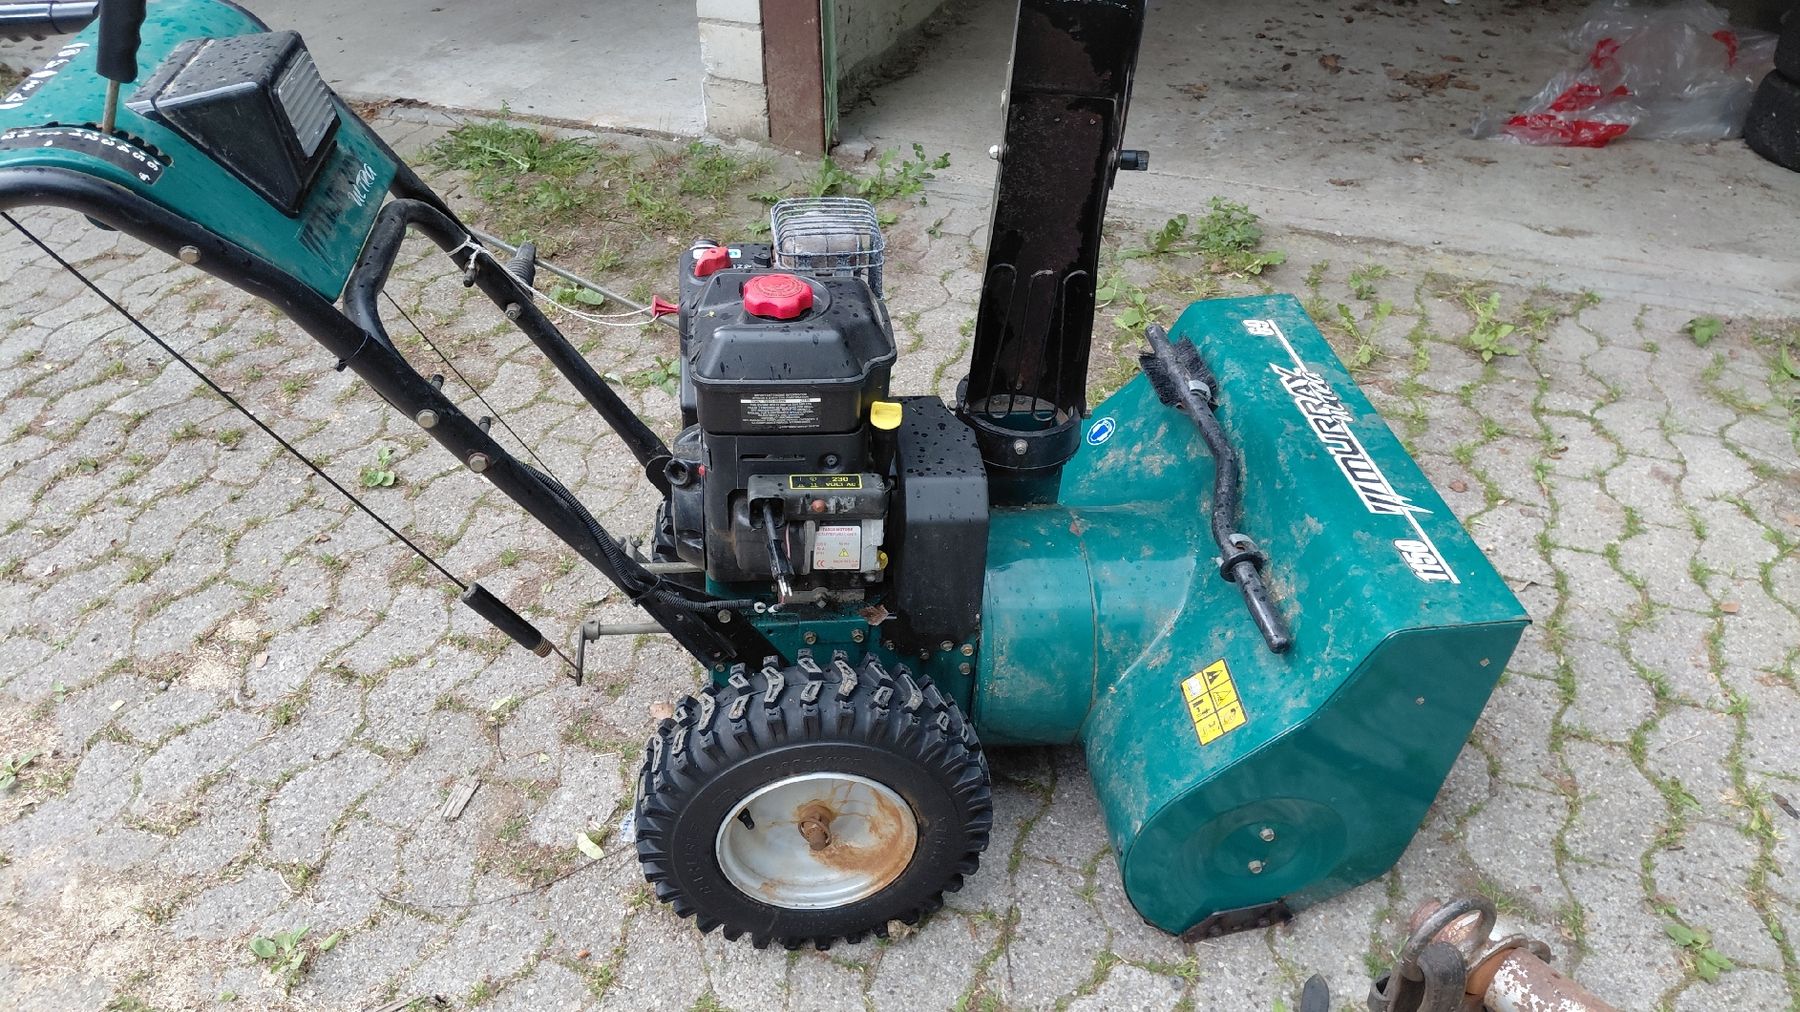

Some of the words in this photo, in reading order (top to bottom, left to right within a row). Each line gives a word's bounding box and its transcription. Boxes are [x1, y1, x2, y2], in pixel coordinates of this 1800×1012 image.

[117, 145, 130, 153] 4
[133, 152, 146, 162] 5
[147, 161, 158, 171] 6
[1269, 363, 1404, 515] MURRAY
